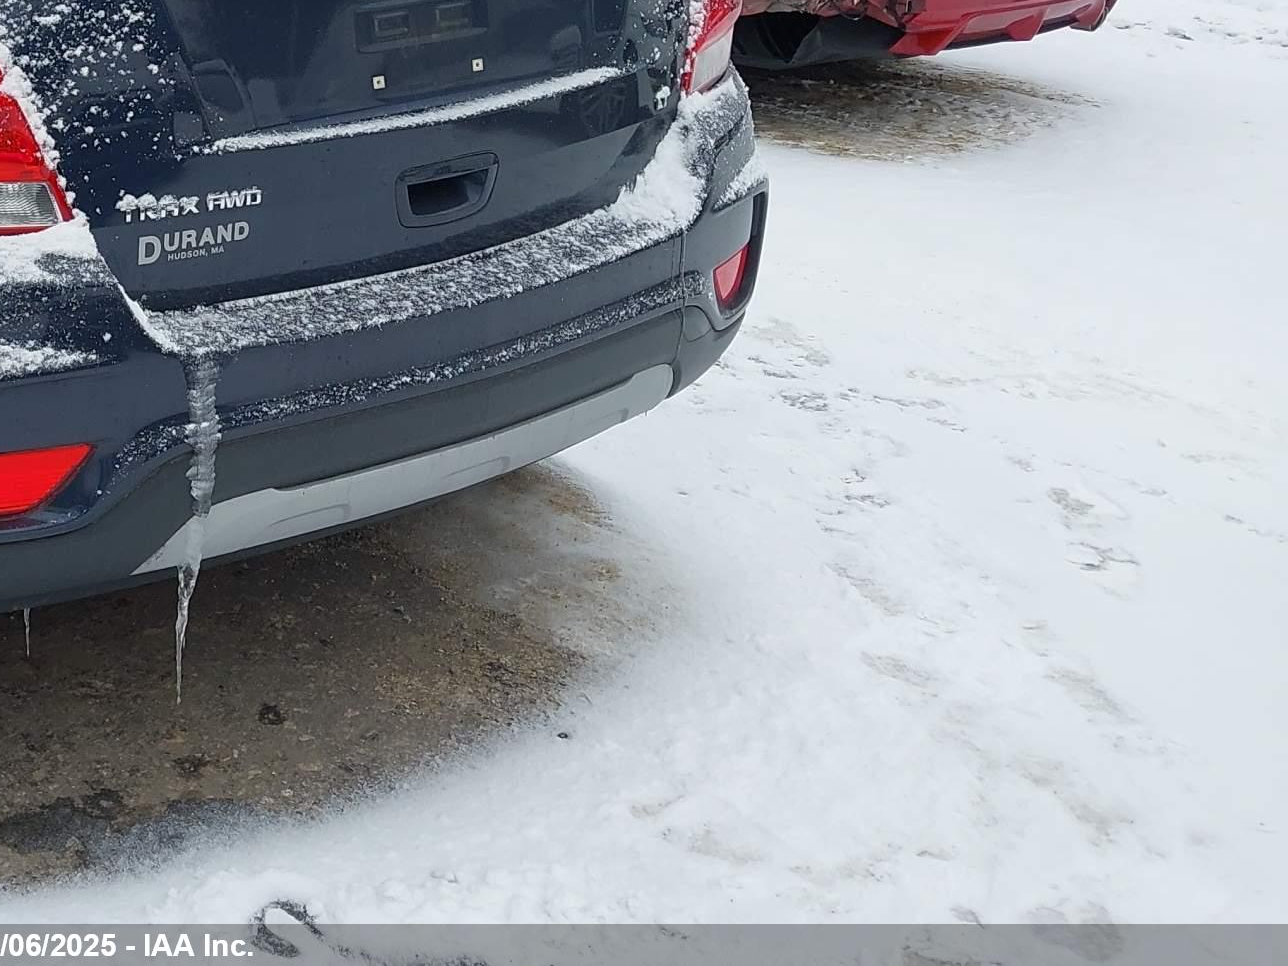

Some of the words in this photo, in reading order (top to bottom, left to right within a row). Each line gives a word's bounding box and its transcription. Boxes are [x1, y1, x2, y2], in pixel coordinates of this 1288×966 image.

[206, 188, 262, 211] AWD
[167, 248, 209, 262] HUDSON,
[211, 245, 225, 255] MA
